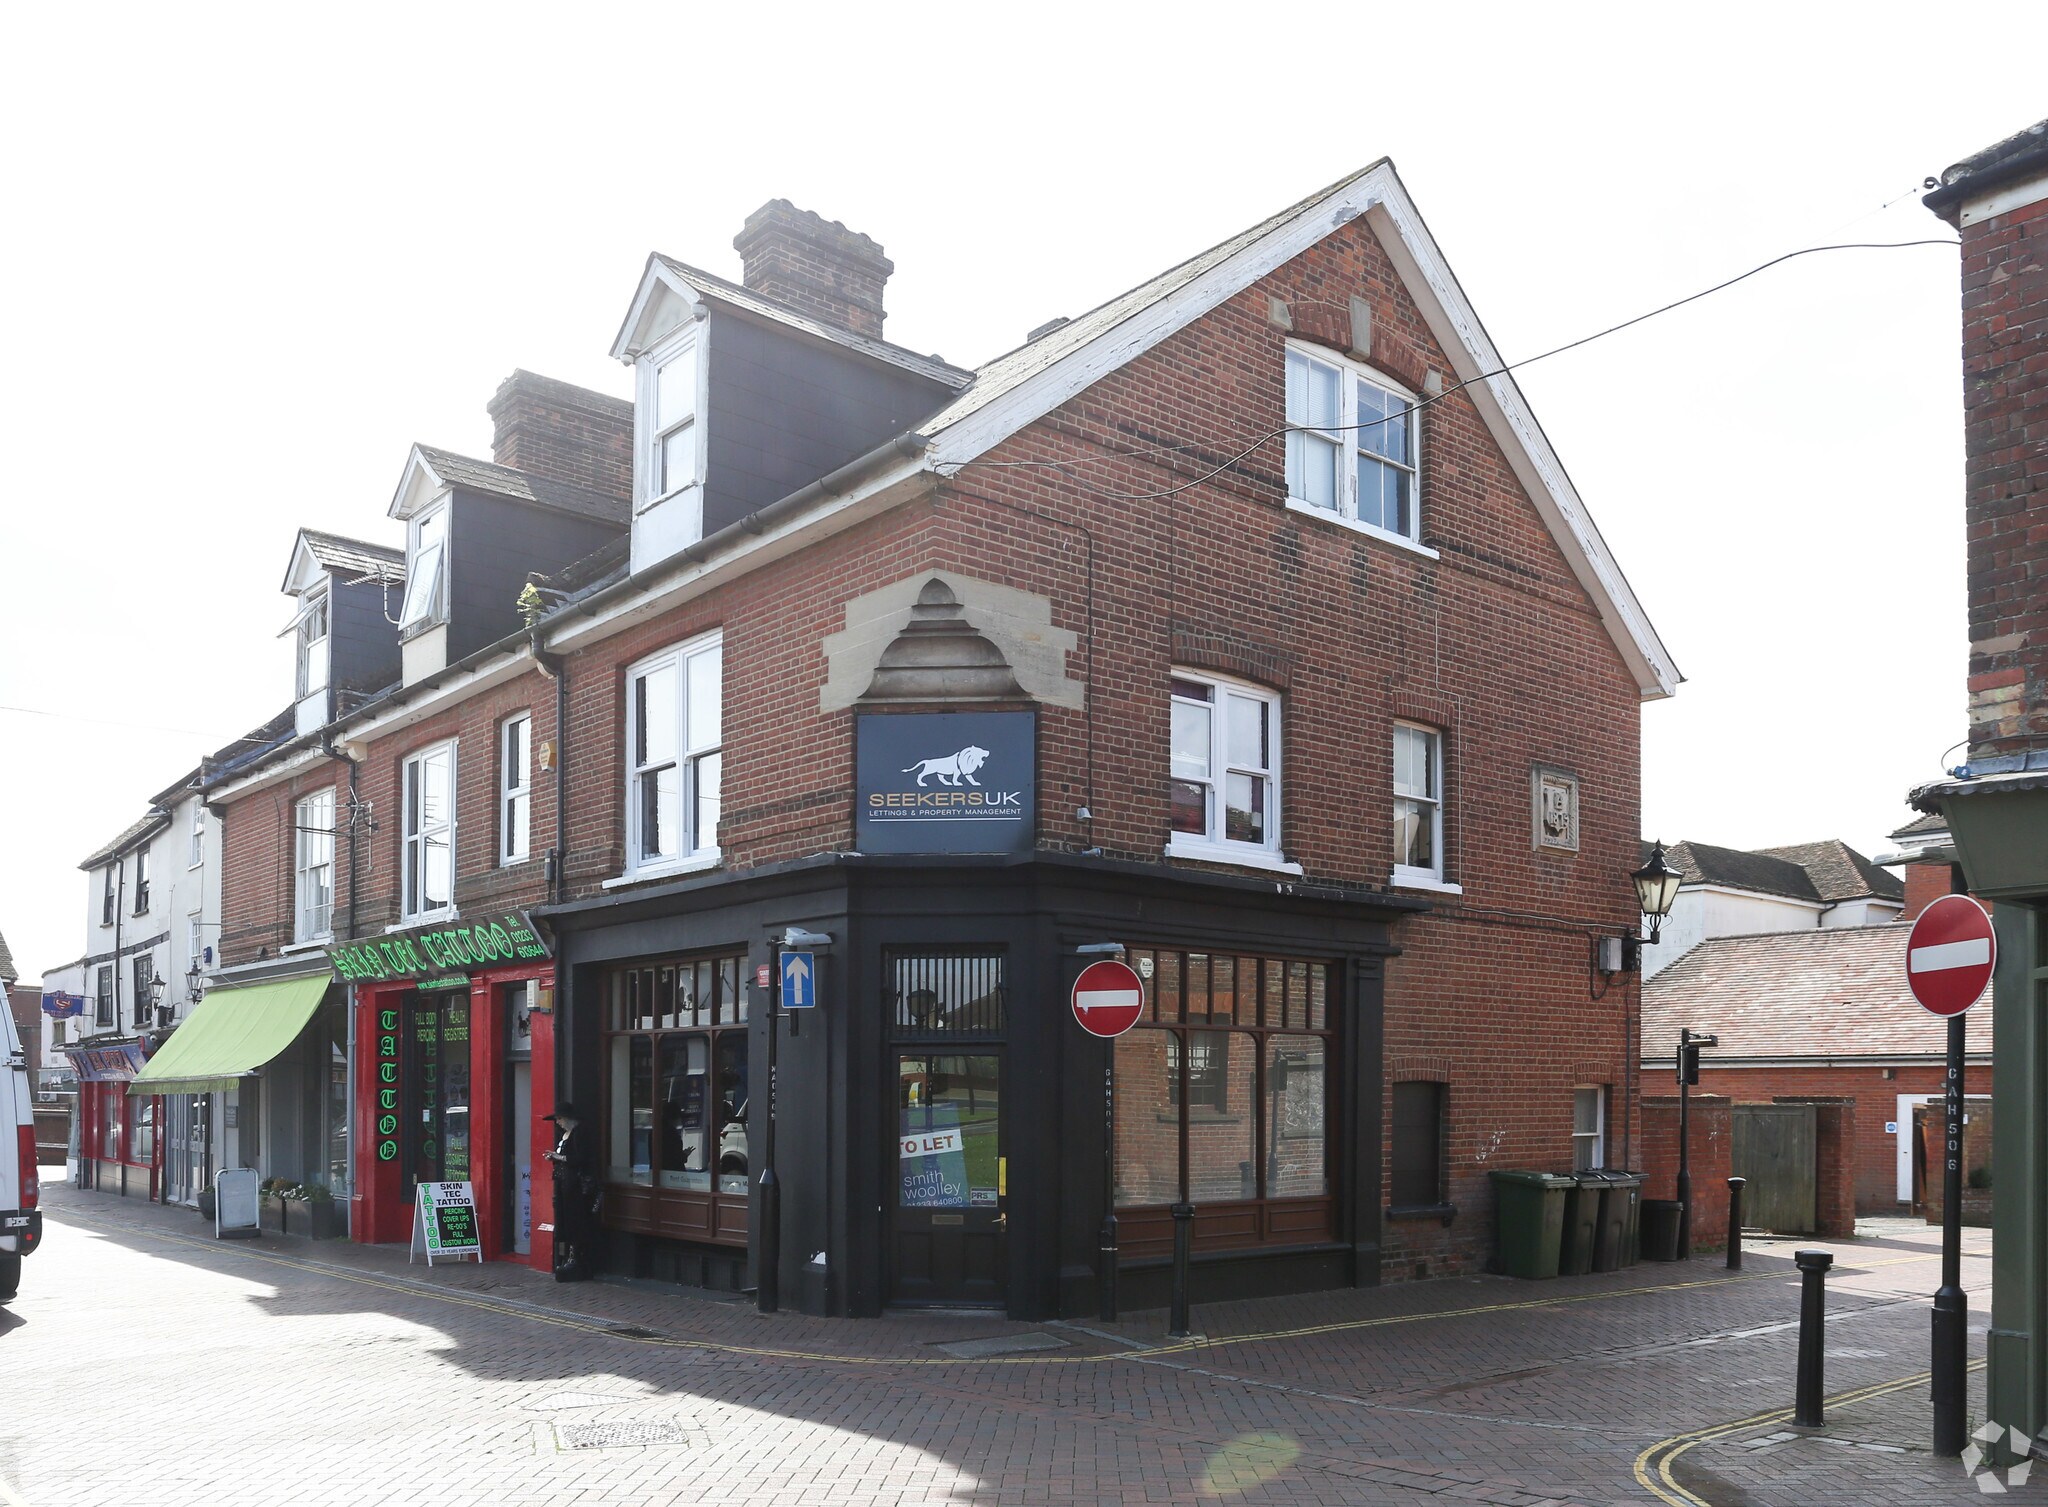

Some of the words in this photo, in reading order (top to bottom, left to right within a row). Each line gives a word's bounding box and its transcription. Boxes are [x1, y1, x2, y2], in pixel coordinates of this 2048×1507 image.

[869, 809, 908, 817] LETTINGS
[919, 808, 962, 816] PROPERTY
[965, 808, 1022, 816] MANAGEMENT
[504, 915, 521, 928] Tel.
[510, 929, 534, 944] 01233
[331, 944, 390, 981] SKIN
[379, 938, 428, 974] TEC
[420, 922, 514, 969] TATTOO
[516, 944, 545, 959] 613644
[415, 1013, 424, 1025] FULL
[448, 1010, 466, 1024] HEALTH
[416, 1028, 437, 1042] PIERCING
[379, 1010, 398, 1161] TATTOO
[451, 1137, 463, 1150] FULL
[923, 1135, 953, 1151] LET
[904, 1170, 944, 1187] smith
[905, 1182, 961, 1199] woolley
[436, 1198, 471, 1206] TATTOO
[422, 1184, 440, 1248] TATTOO
